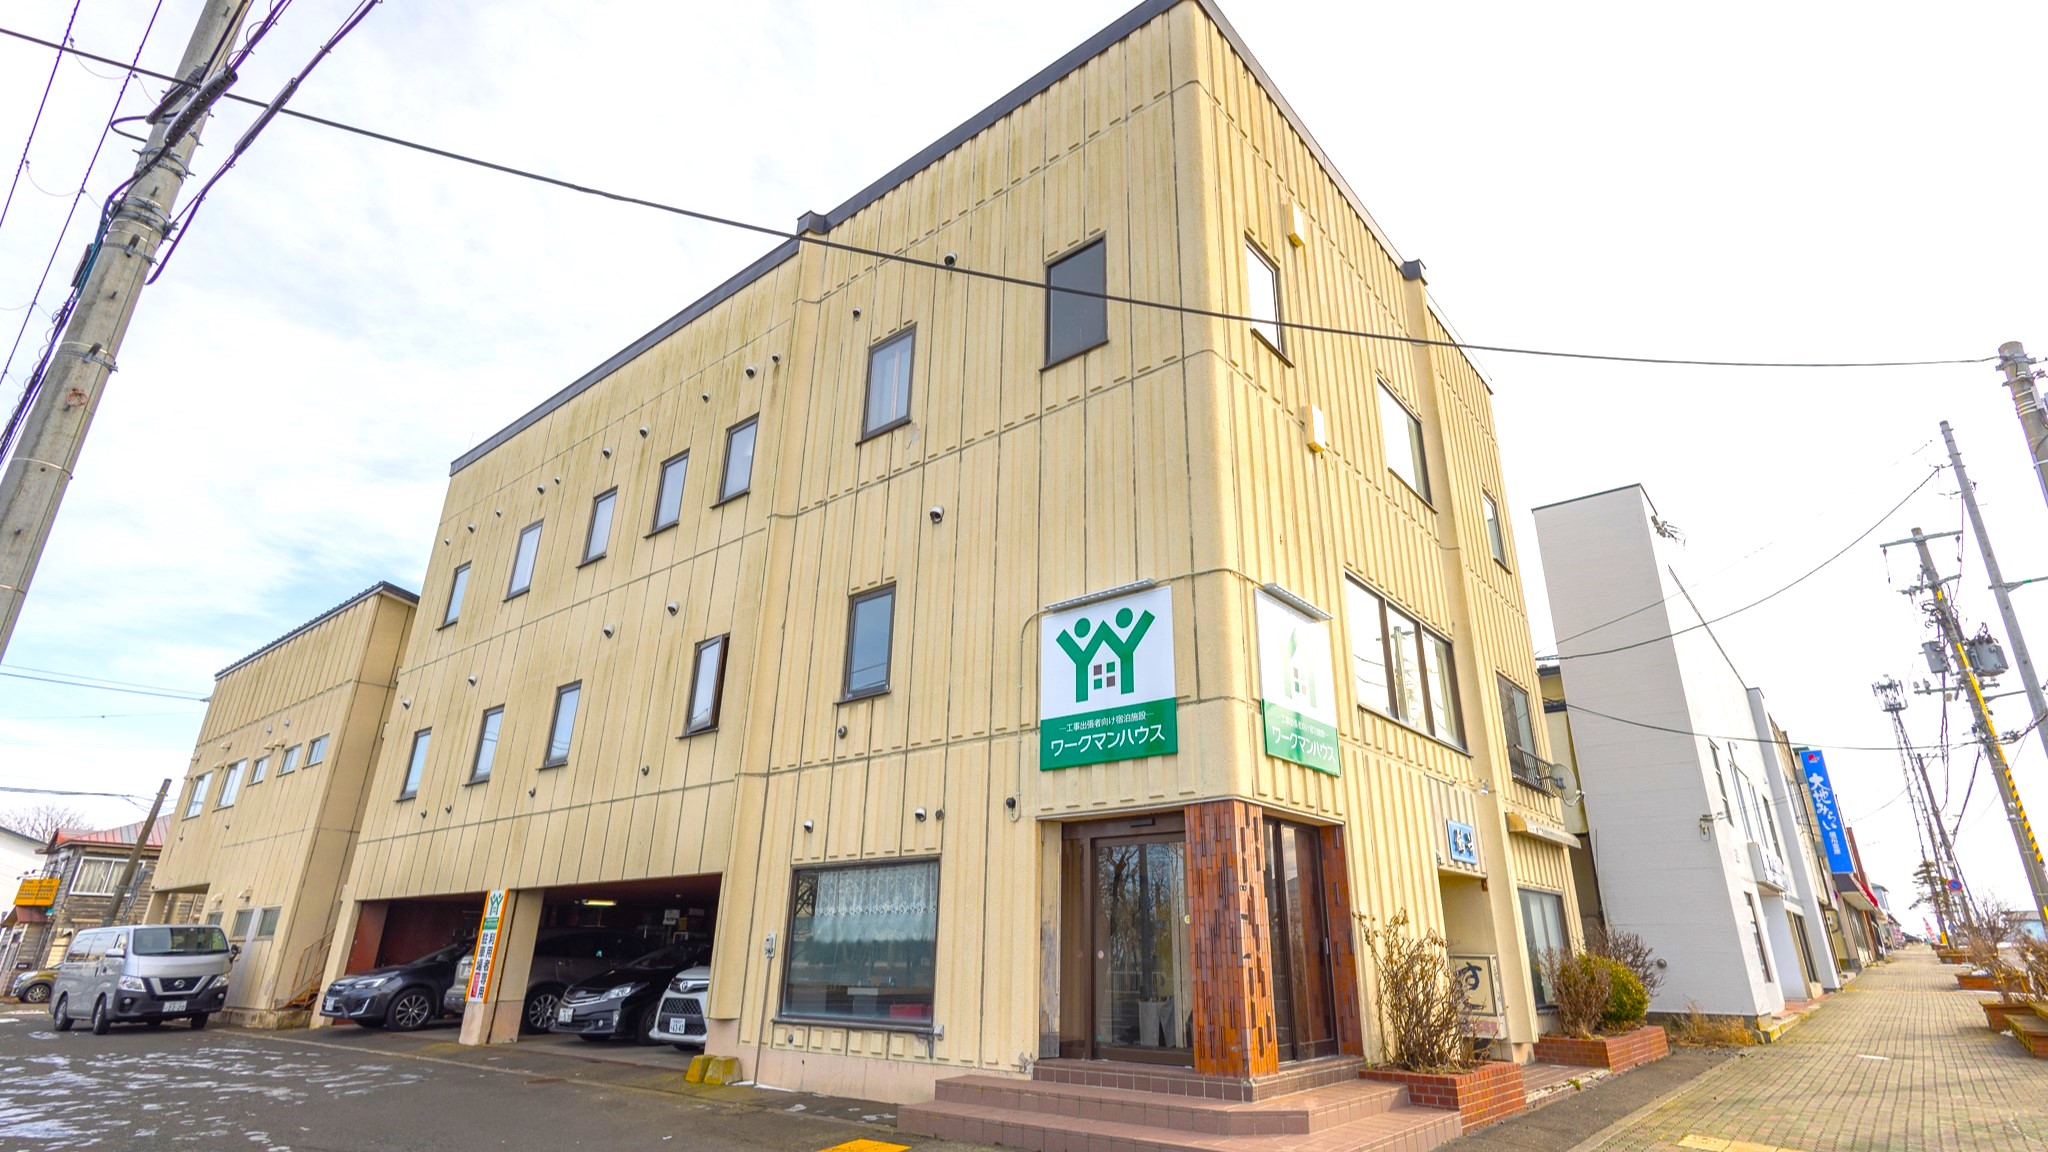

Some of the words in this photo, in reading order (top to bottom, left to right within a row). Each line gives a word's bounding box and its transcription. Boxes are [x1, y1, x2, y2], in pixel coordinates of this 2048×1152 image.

[1051, 724, 1165, 757] ワークマンハウス
[1271, 725, 1336, 763] ワークマンハウス
